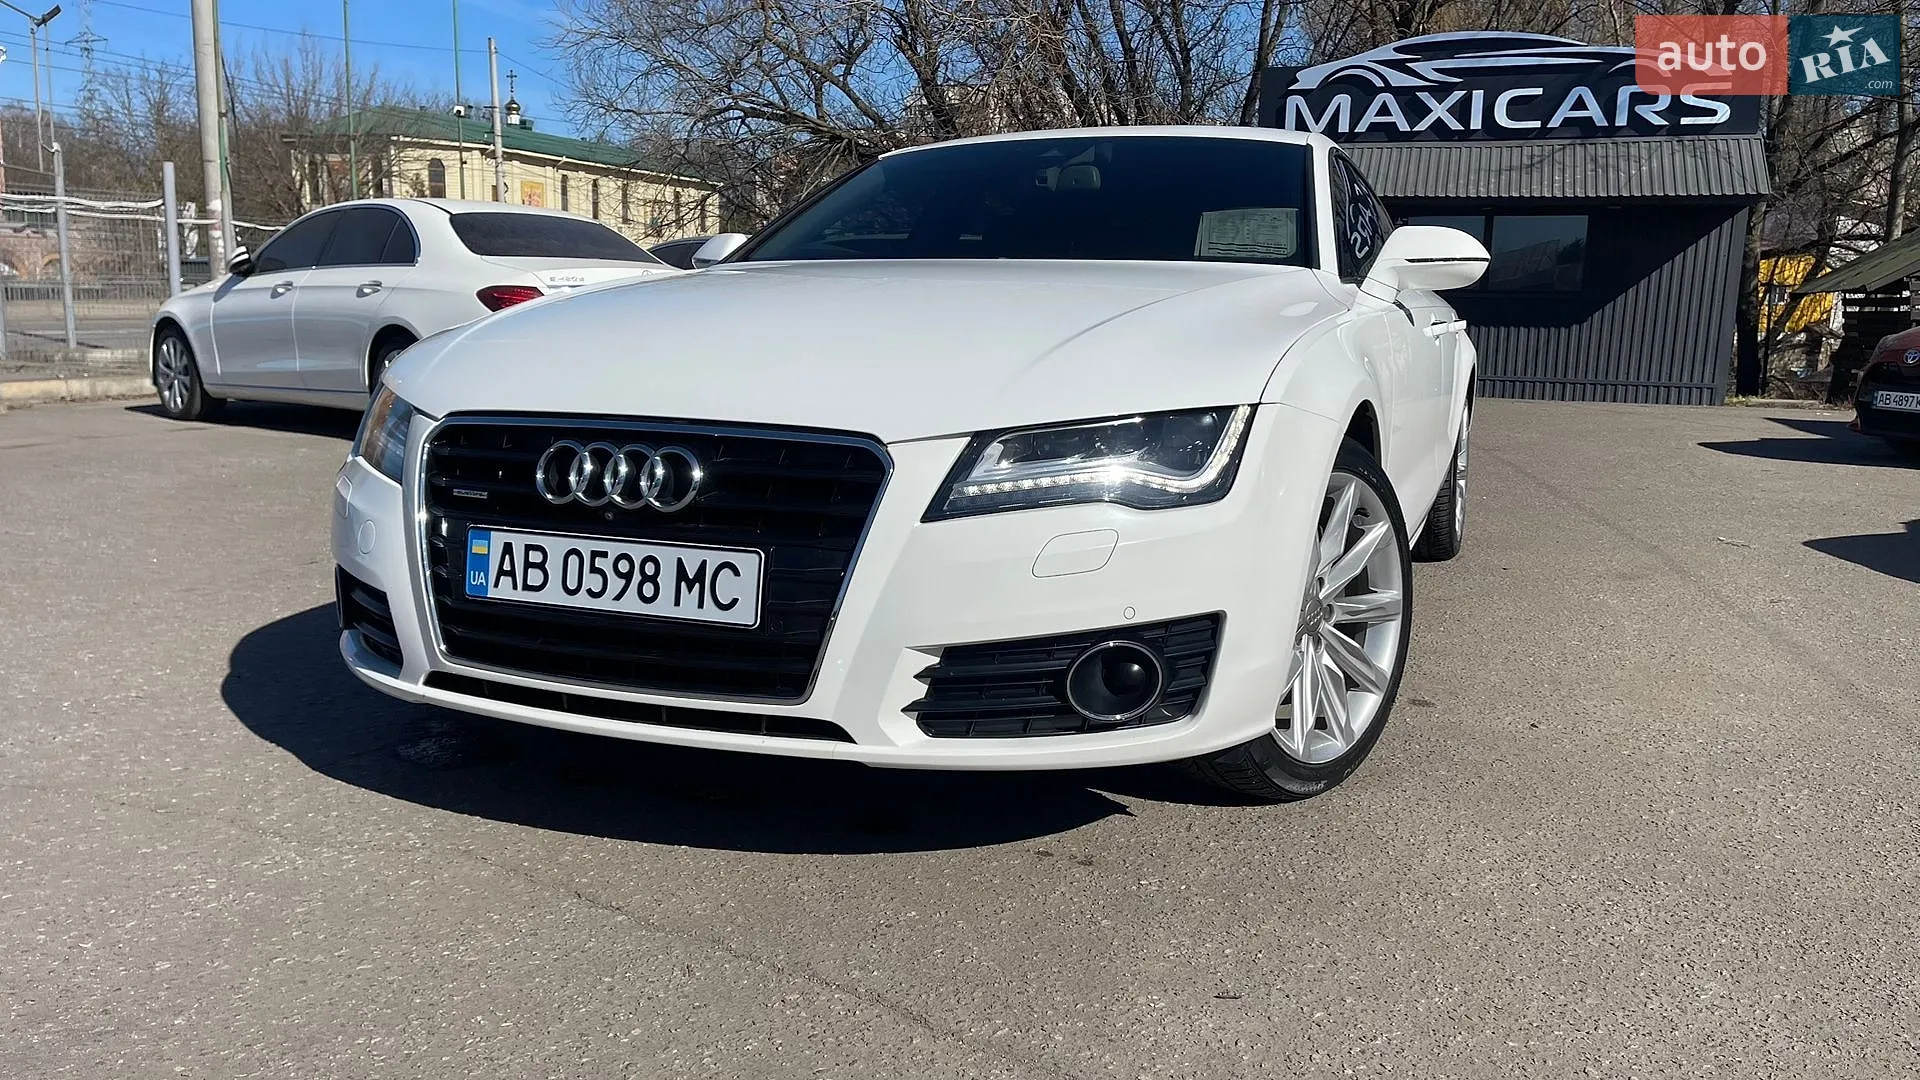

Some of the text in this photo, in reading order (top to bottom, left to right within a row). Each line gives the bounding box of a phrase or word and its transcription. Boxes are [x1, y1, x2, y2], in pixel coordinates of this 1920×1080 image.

[1284, 82, 1731, 134] MAXICARS
[1879, 393, 1891, 406] AB
[1893, 394, 1915, 408] 4897
[470, 570, 486, 586] UA
[493, 541, 741, 611] AB 0598 MC
